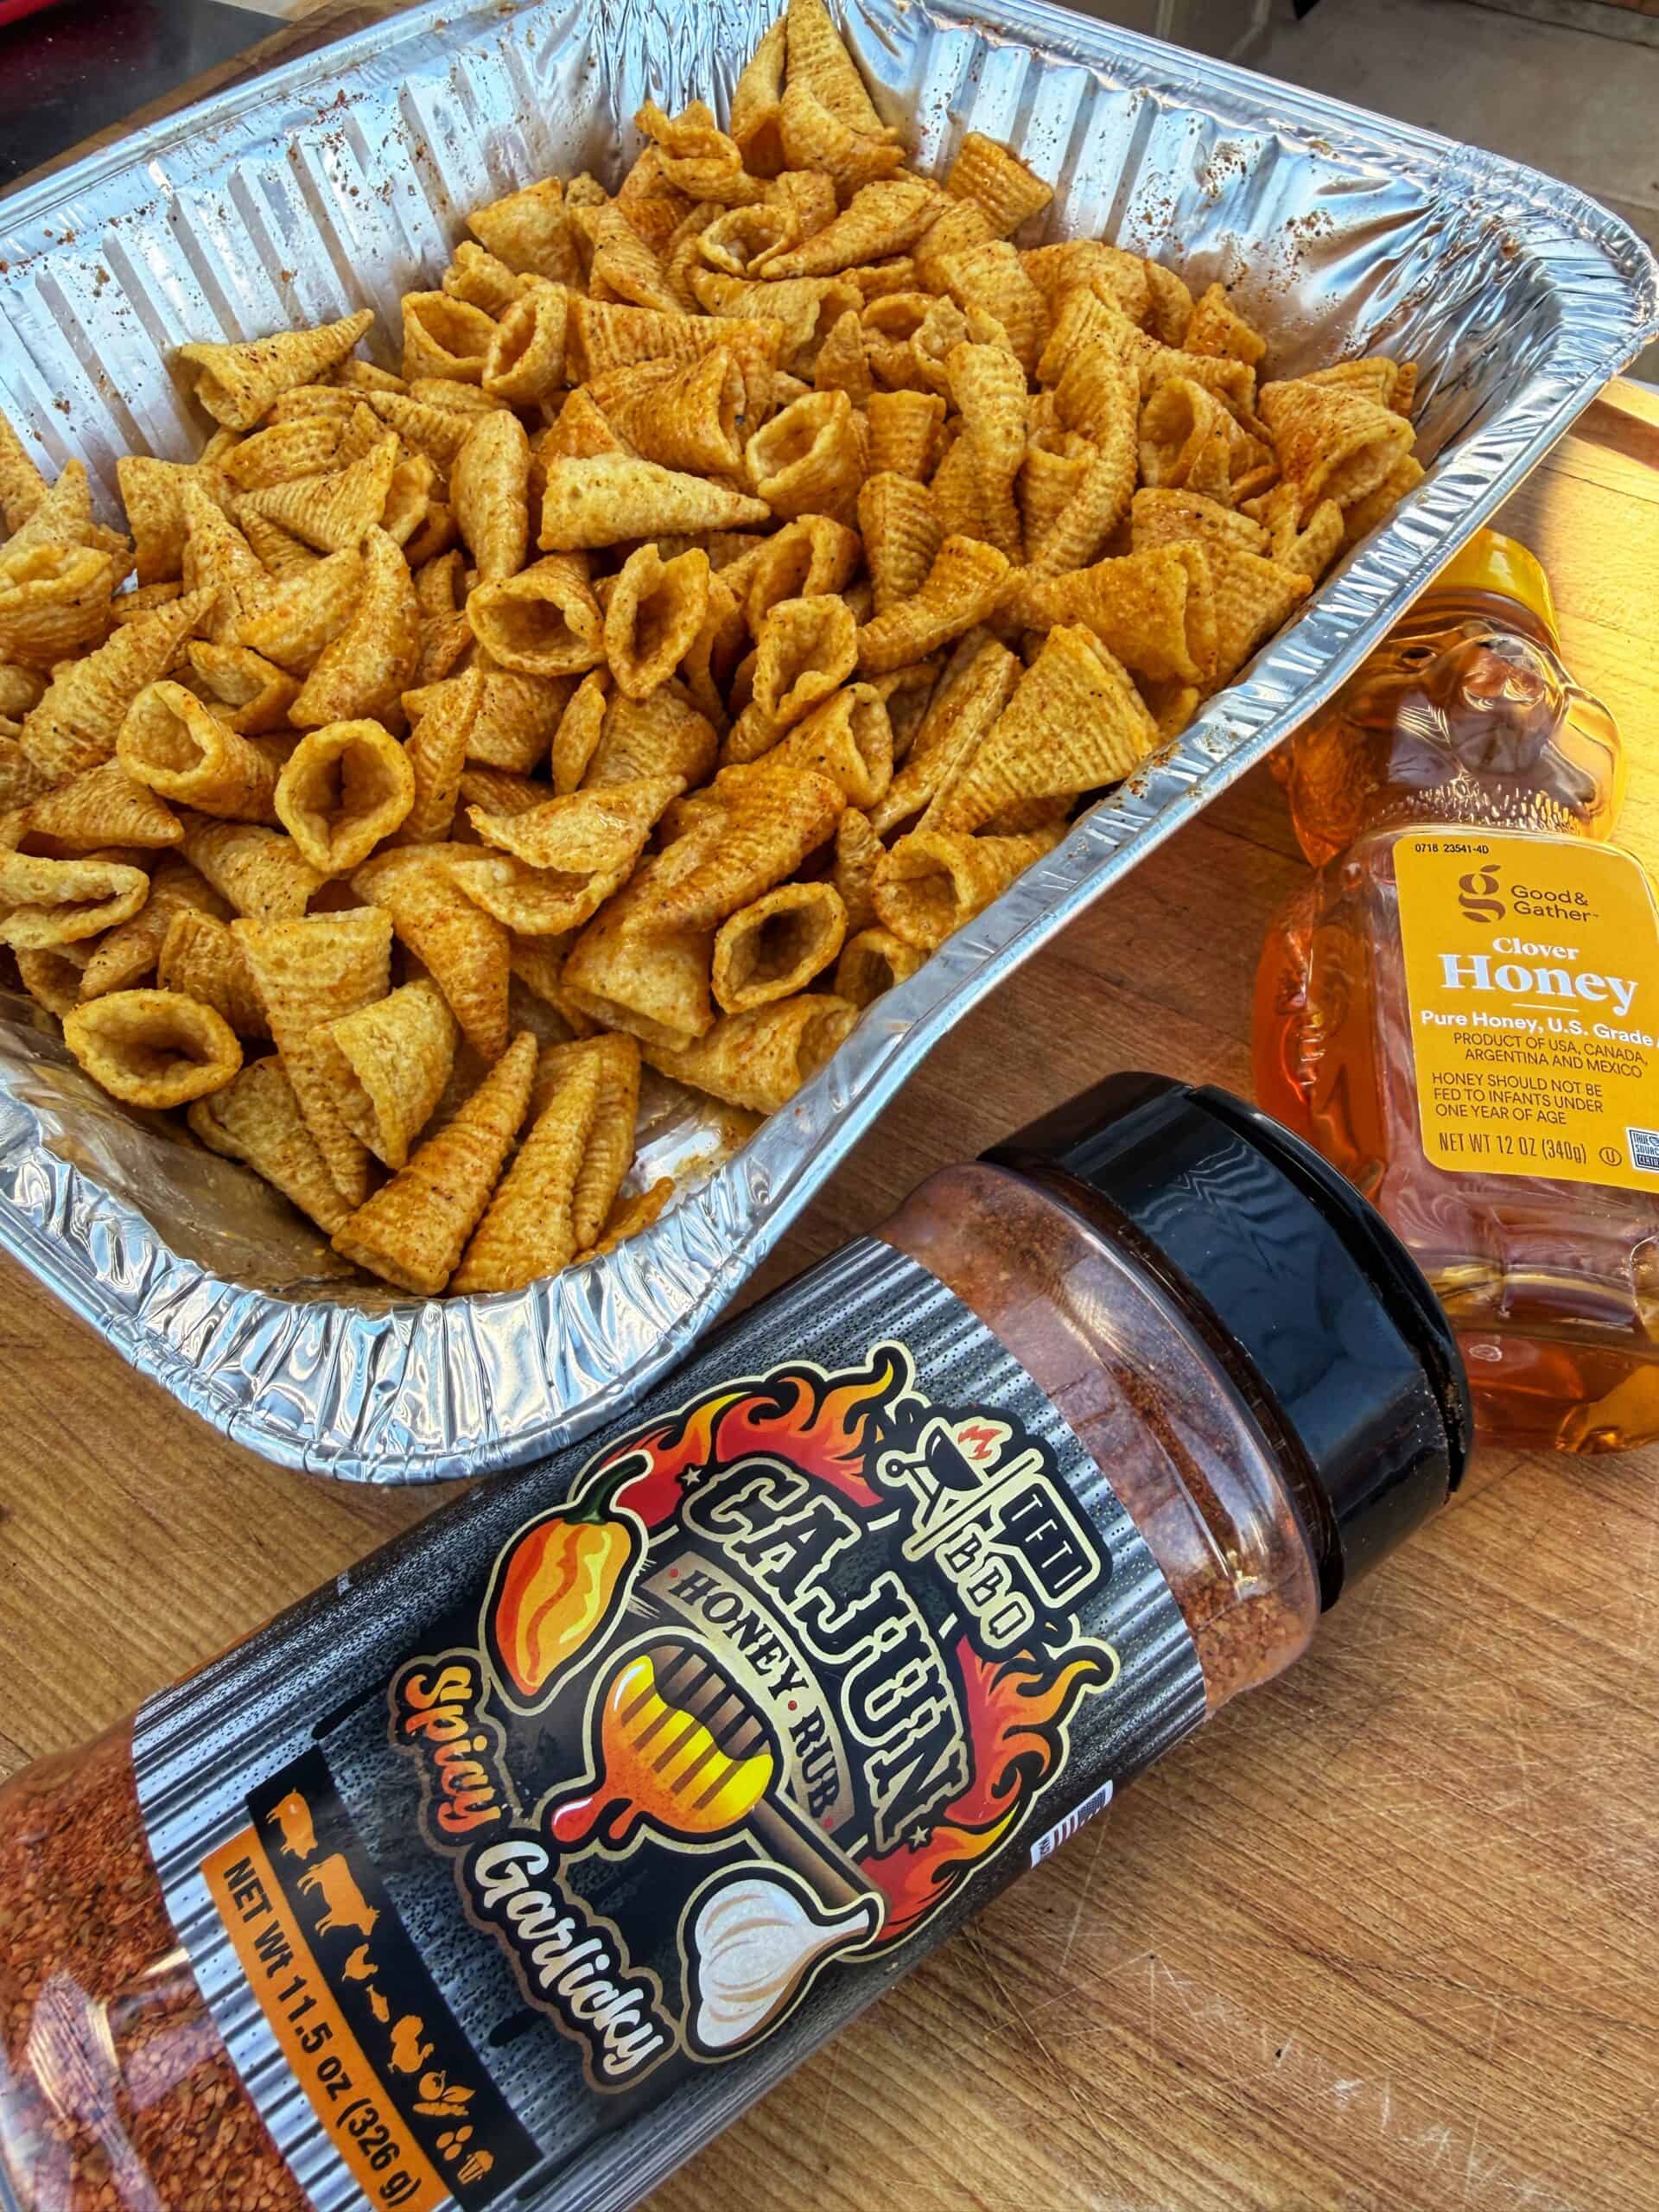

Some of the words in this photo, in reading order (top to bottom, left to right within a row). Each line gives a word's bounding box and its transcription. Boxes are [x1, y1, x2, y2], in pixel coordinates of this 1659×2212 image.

[1492, 937, 1580, 961] Clover
[1437, 953, 1639, 1017] Honey
[1421, 1009, 1467, 1027] Pure
[1472, 1011, 1544, 1034] Honey,
[1548, 1017, 1589, 1037] U.S.
[1592, 1023, 1654, 1046] Grade
[1453, 1032, 1522, 1047] PRODUCT
[1526, 1036, 1545, 1050] OF
[1584, 1044, 1648, 1065] CANADA,
[1465, 1048, 1548, 1066] ARGENTINA
[1552, 1055, 1584, 1070] AND
[1587, 1059, 1643, 1078] MEXICO
[1432, 1072, 1484, 1086] HONEY
[1487, 1074, 1548, 1090] SHOULD
[1551, 1079, 1582, 1095] NOT
[1586, 1084, 1603, 1097] BE
[1433, 1088, 1461, 1101] FED
[1464, 1088, 1485, 1102] TO
[1489, 1090, 1551, 1107] INFANTS
[1554, 1096, 1604, 1113] UNDER
[1435, 1103, 1468, 1117] ONE
[1471, 1105, 1510, 1120] YEAR
[1512, 1108, 1533, 1121] OF
[1536, 1109, 1567, 1125] AGE
[1439, 1132, 1465, 1152] NET
[1468, 1133, 1491, 1154] WT
[1496, 1135, 1515, 1154] 12
[1518, 1137, 1538, 1157] OZ
[1541, 1138, 1587, 1165] (340g)
[683, 1457, 968, 1852] CAJUN
[667, 1569, 810, 1700] HONEY
[789, 1707, 840, 1825] RUB
[404, 1666, 501, 1833] Spicy
[474, 1840, 664, 2075] Garlicky
[223, 1855, 275, 1924] NET
[253, 1919, 296, 1980] Wt
[277, 1974, 334, 2055] 11.5
[316, 2055, 353, 2102] oz
[335, 2096, 402, 2172] (326
[378, 2169, 423, 2209] g)
